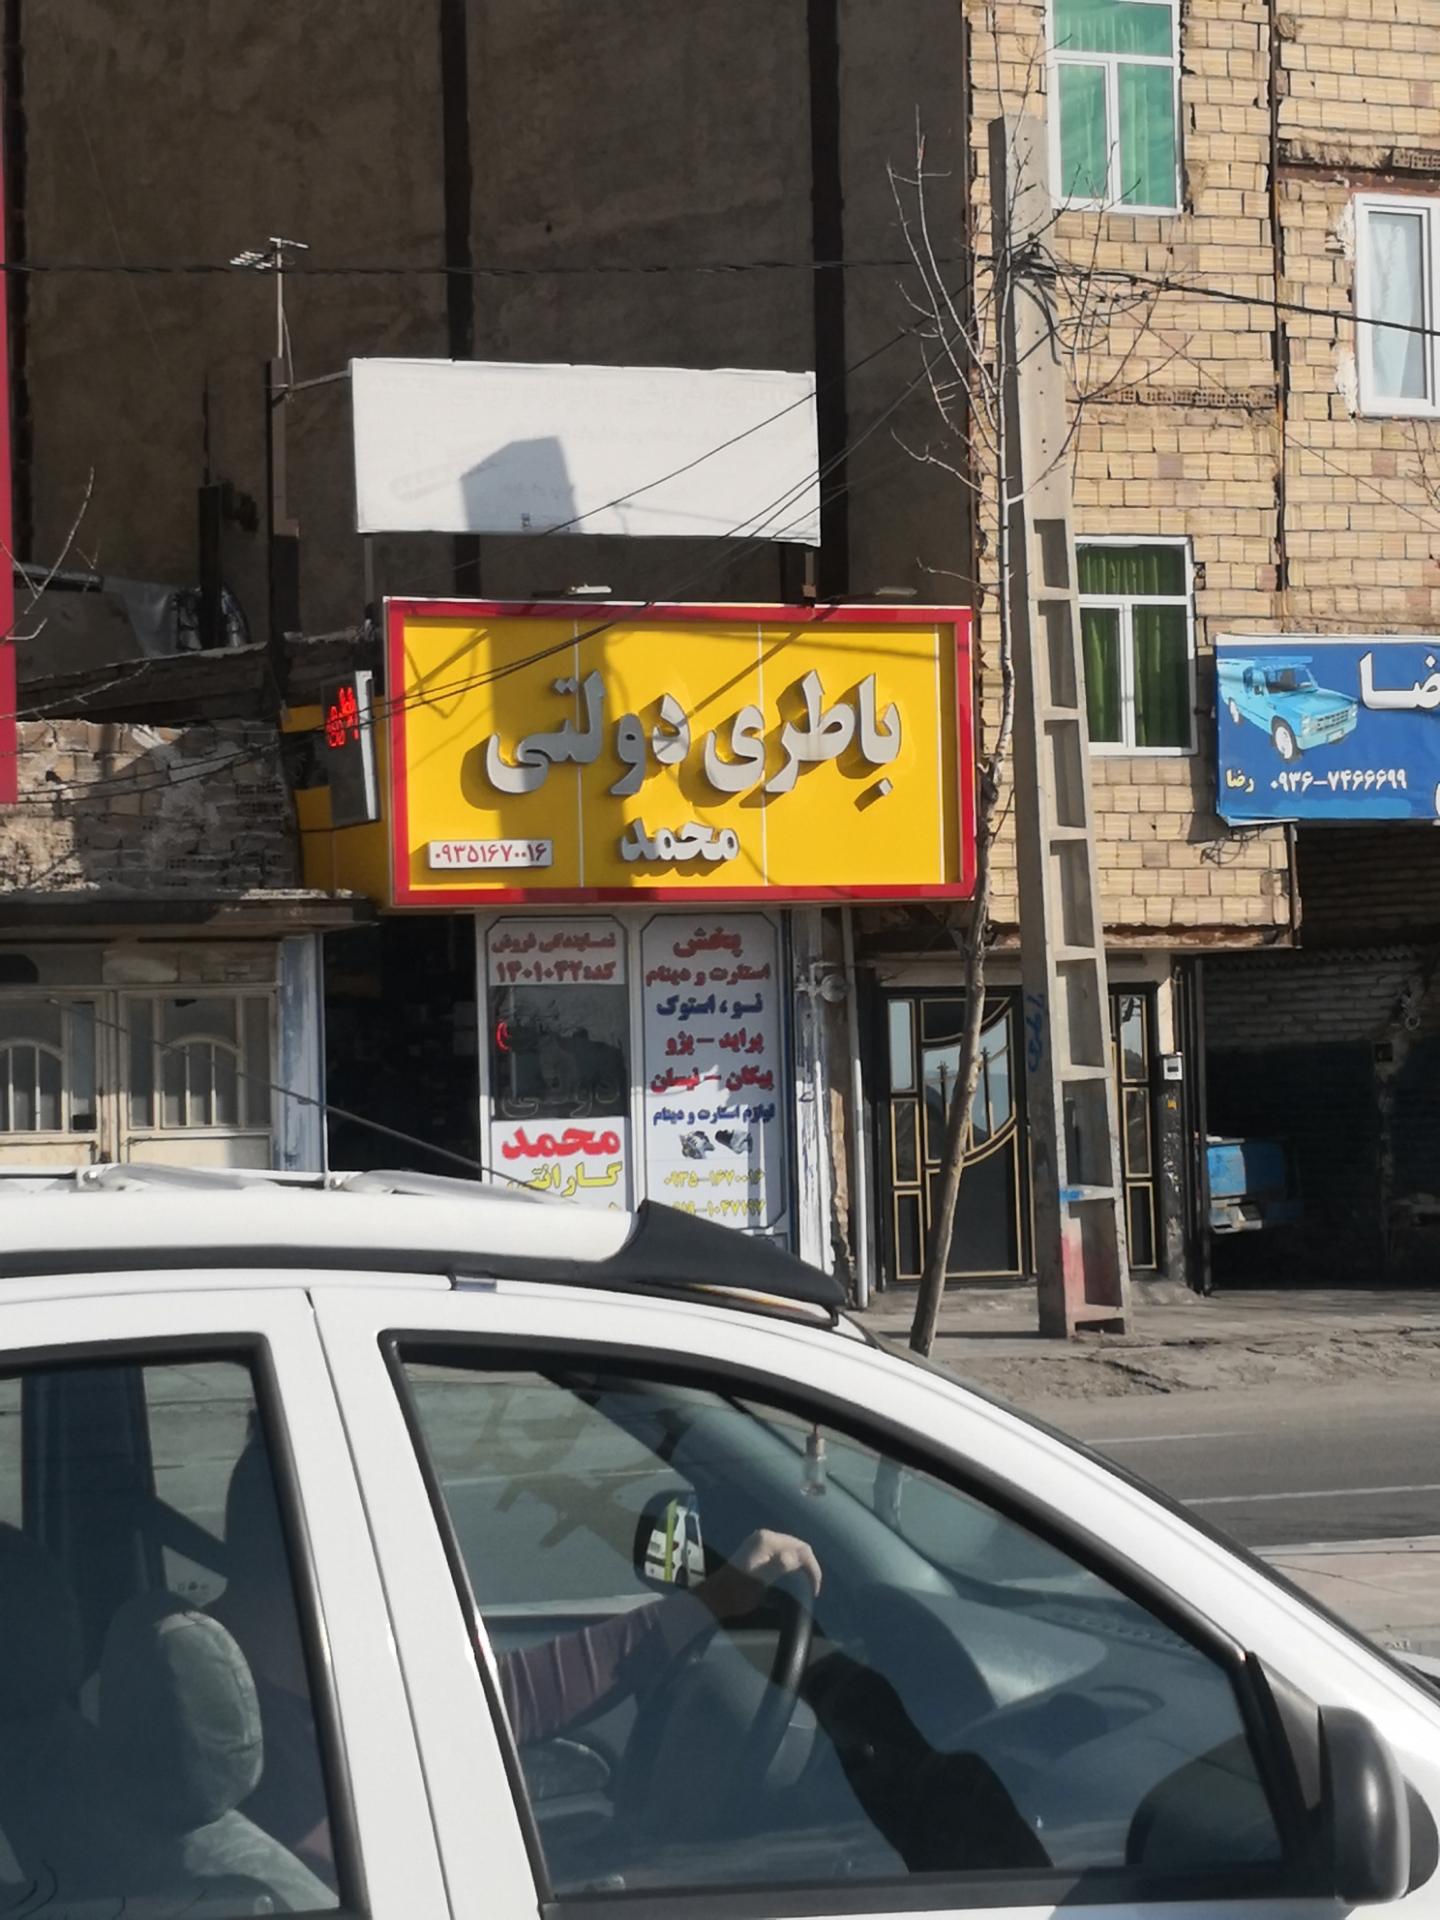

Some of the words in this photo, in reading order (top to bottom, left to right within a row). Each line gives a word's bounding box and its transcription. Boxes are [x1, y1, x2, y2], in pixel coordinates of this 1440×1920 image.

[486, 668, 691, 795] دولتی
[705, 668, 902, 797] باطری
[1226, 768, 1255, 793] رضا
[435, 842, 548, 863] ۰۹۳۵۱۶۷۰۰۱۶
[620, 817, 739, 863] محمد
[491, 931, 537, 954] فروش
[539, 932, 616, 953] نمایندگی
[673, 927, 743, 958] پخش
[645, 965, 692, 988] دینام
[694, 971, 706, 987] و
[709, 963, 771, 986] استارت
[656, 993, 716, 1021] استوک
[665, 1030, 695, 1056] پژو
[719, 1027, 764, 1054] پراید
[650, 1067, 700, 1093] نیسان
[725, 1065, 774, 1092] پیکان
[653, 1107, 685, 1126] دینام
[687, 1111, 696, 1125] و
[697, 1104, 740, 1124] استارت
[501, 1126, 621, 1160] محمد
